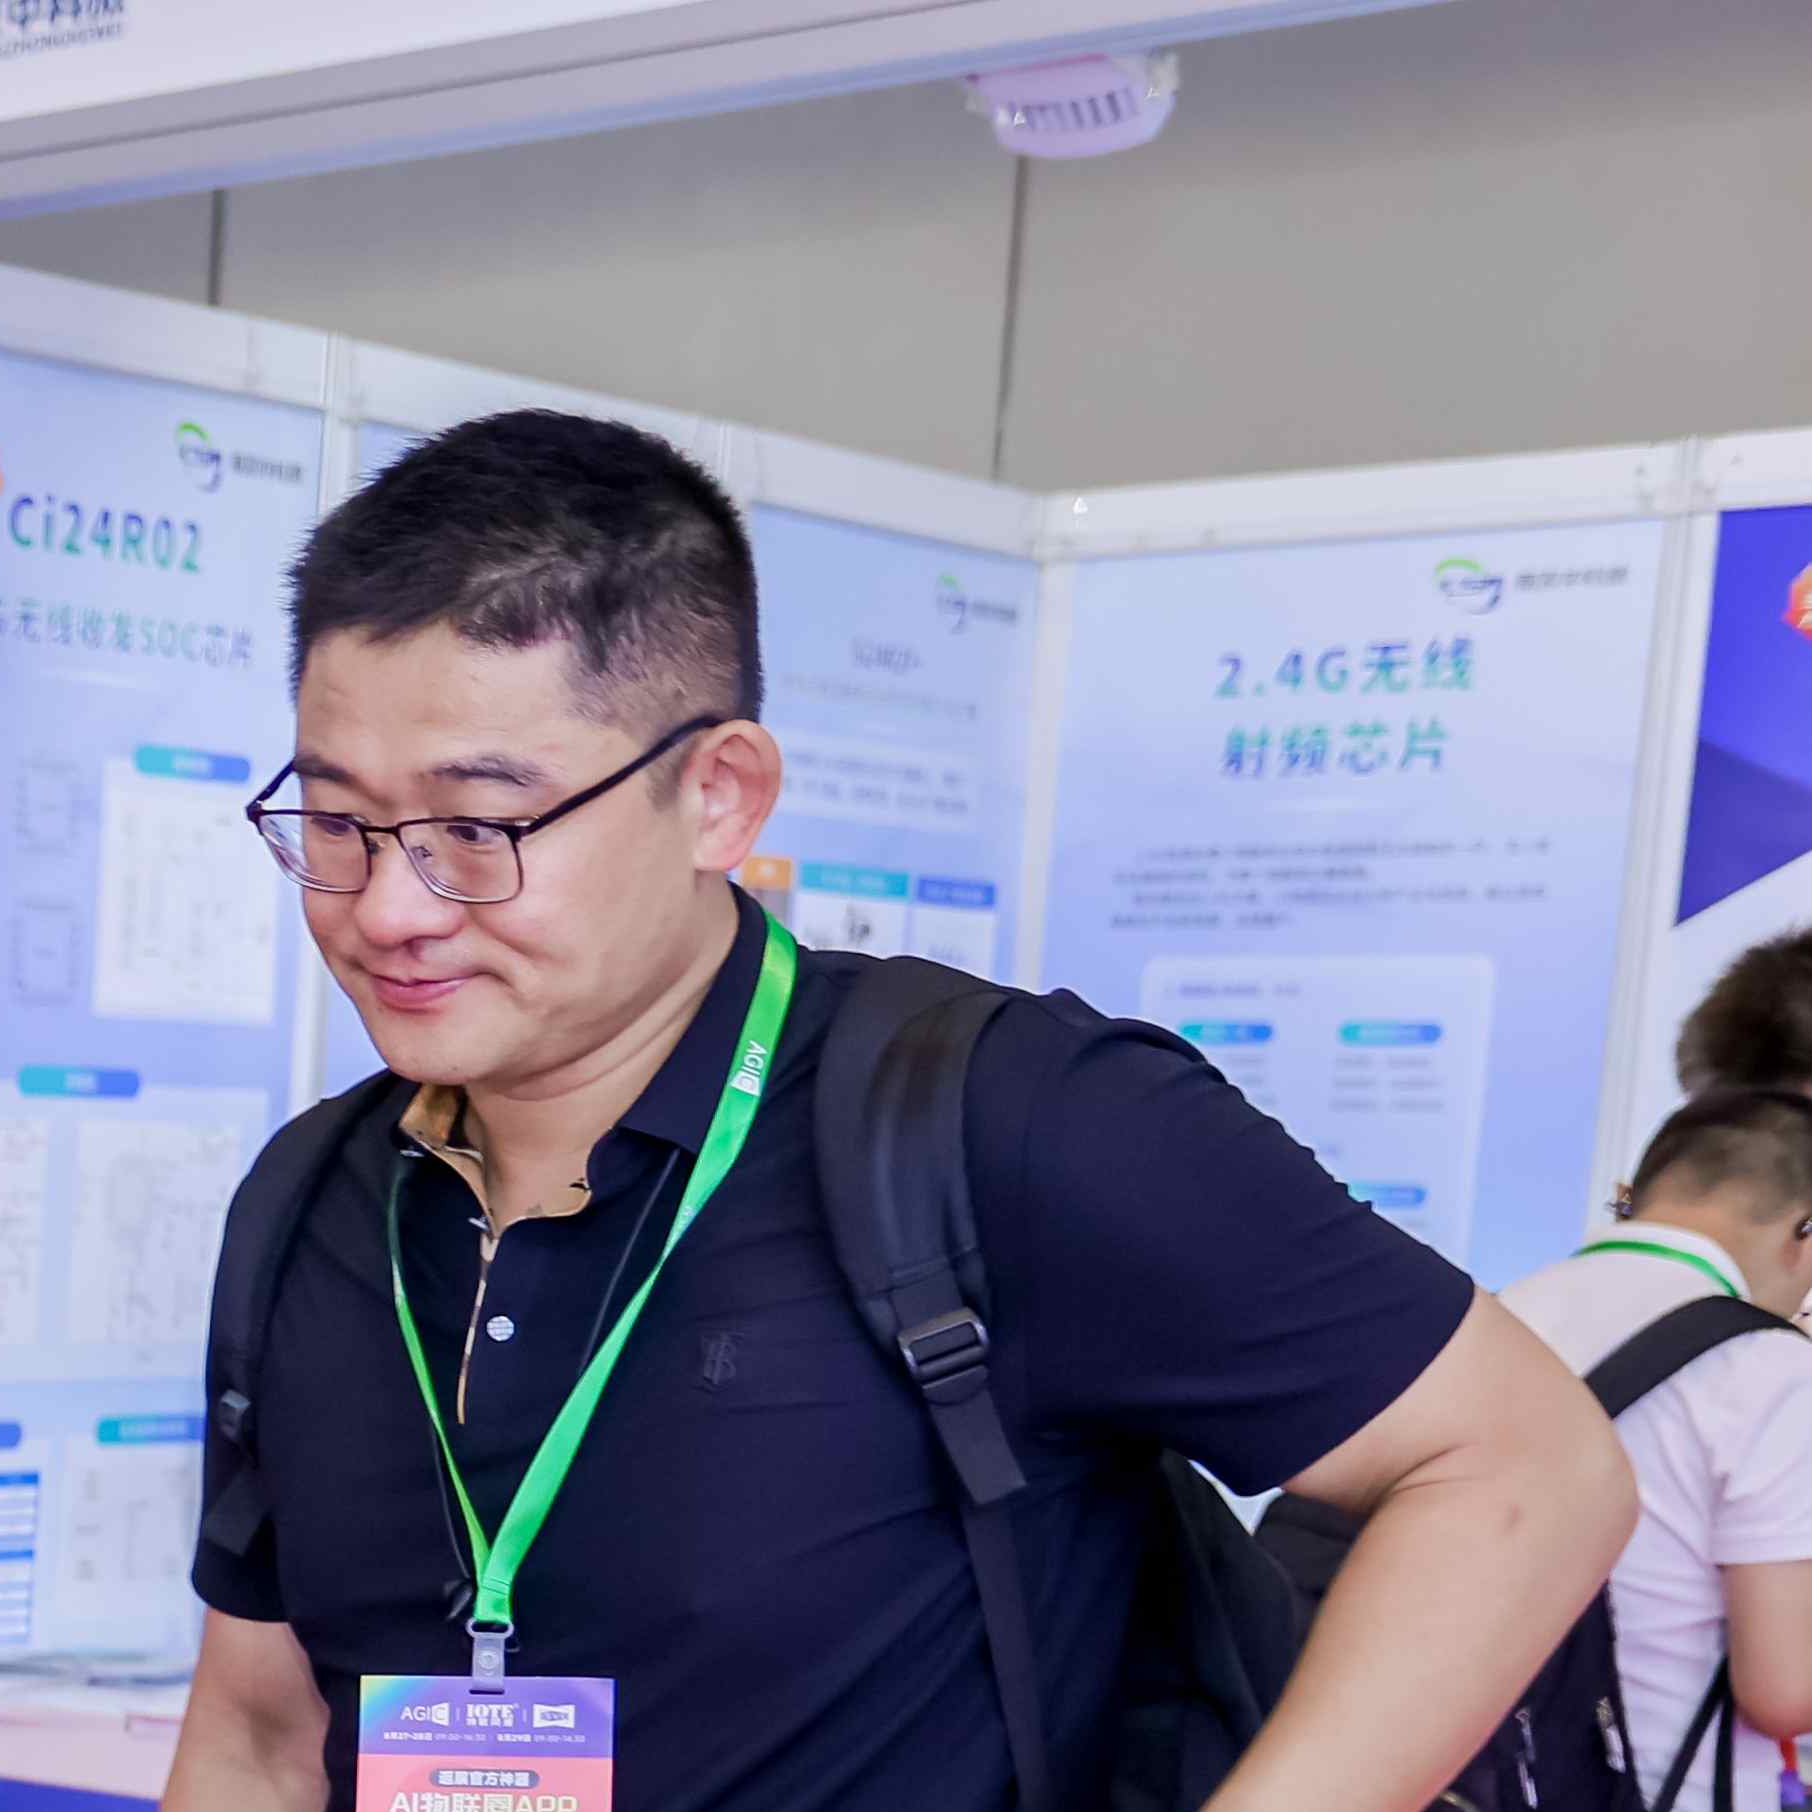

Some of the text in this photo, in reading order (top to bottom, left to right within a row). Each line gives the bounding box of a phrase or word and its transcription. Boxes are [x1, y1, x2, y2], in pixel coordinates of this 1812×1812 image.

[9, 494, 203, 574] Ci24R02
[1214, 636, 1474, 698] 2.4G无线
[1221, 716, 1449, 778] 射频芯片
